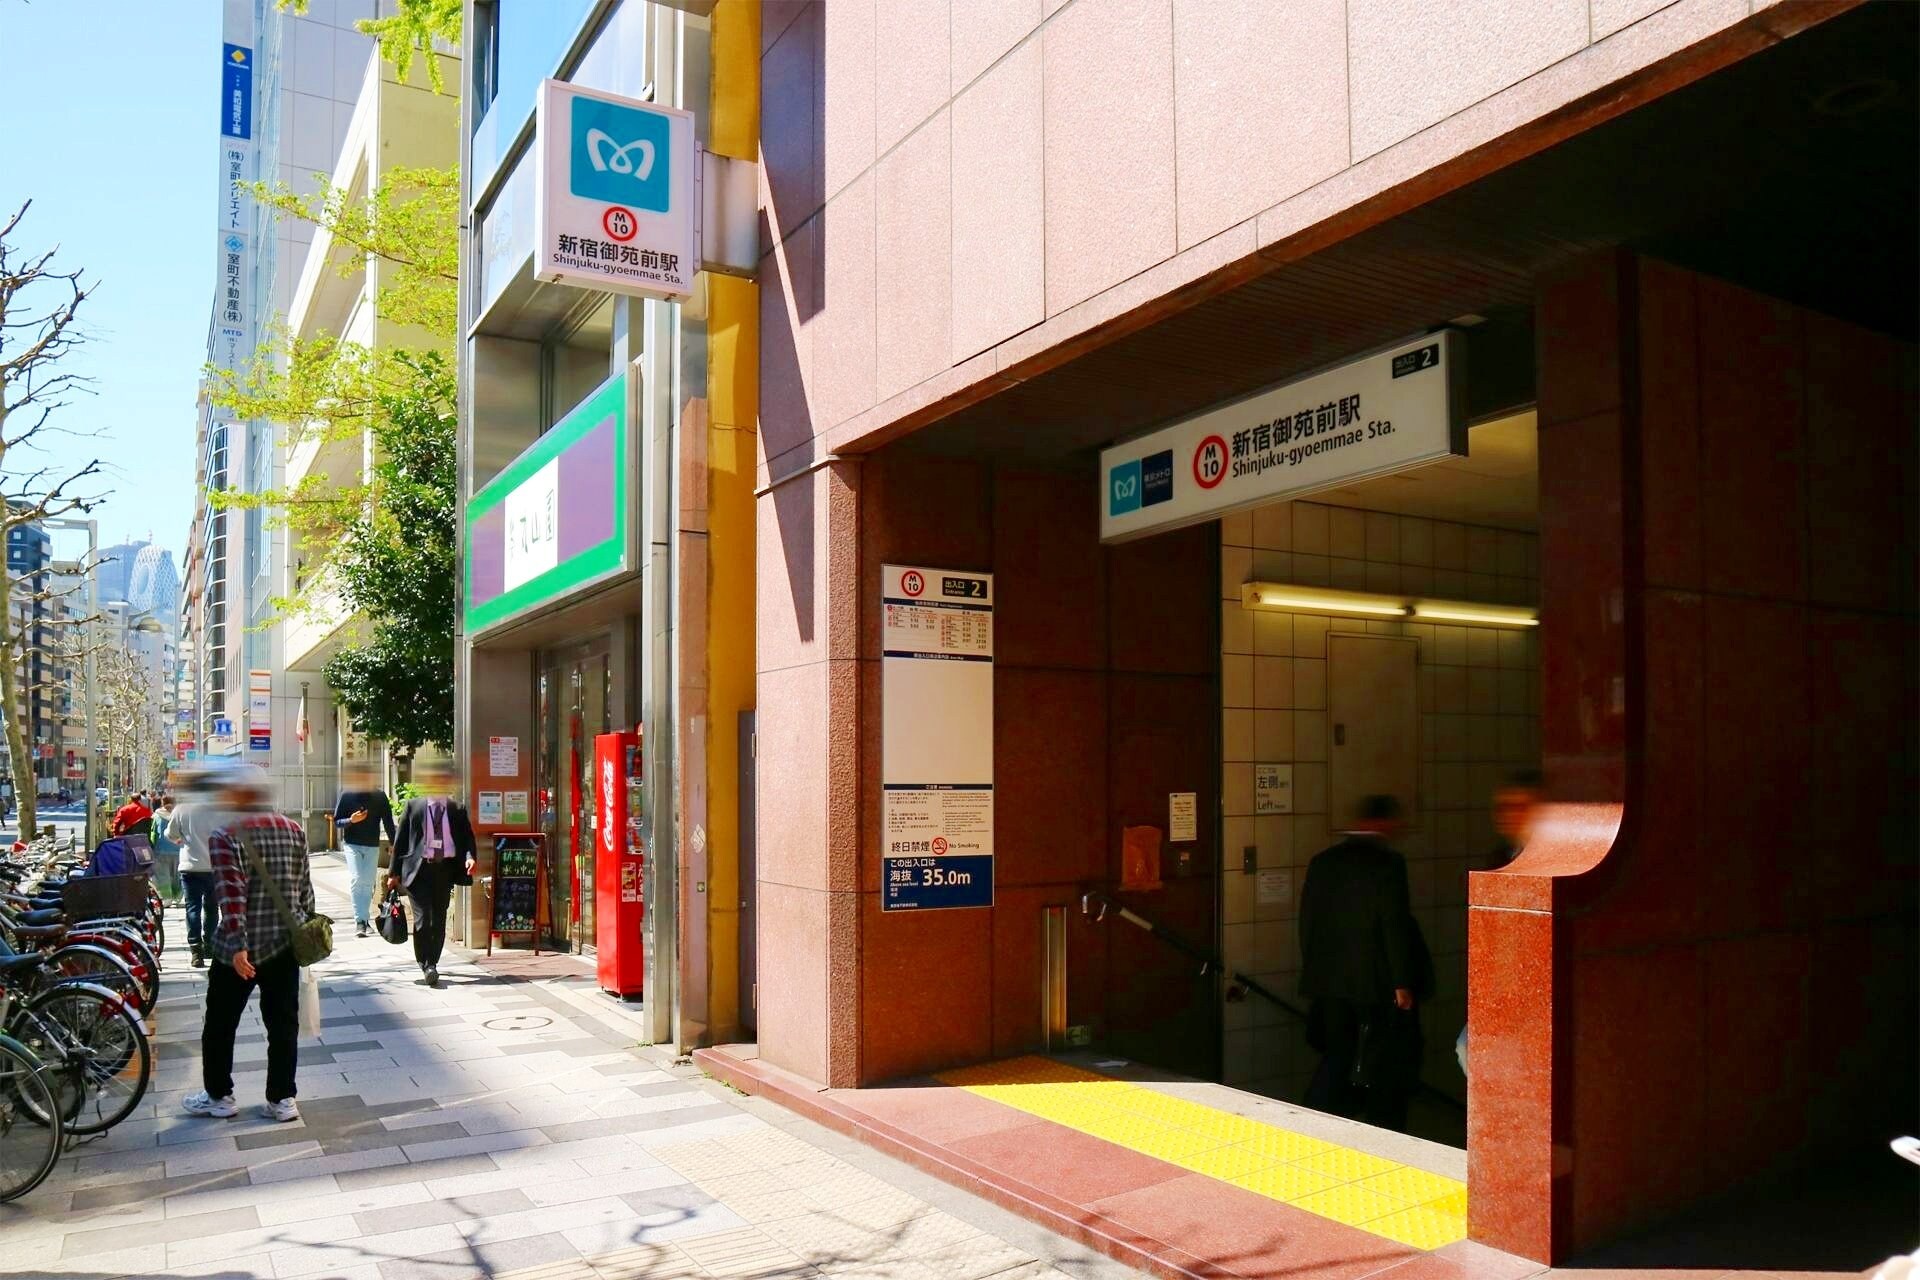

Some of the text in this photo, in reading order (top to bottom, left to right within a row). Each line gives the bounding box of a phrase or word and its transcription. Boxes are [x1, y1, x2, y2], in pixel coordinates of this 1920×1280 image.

[614, 212, 626, 223] M
[612, 223, 629, 235] 10
[558, 233, 679, 273] 新宿御苑前駅
[553, 253, 683, 285] Shinjuku-gyoemmae Sta.
[1421, 348, 1432, 367] 2
[1232, 393, 1361, 459] 新宿御苑前駅
[1205, 444, 1216, 461] M
[1232, 418, 1396, 478] Shinjuku-gyoemmae Sta.
[1203, 460, 1219, 478] 10
[908, 575, 917, 583] M
[908, 583, 919, 592] 10
[945, 580, 981, 596] 出入口 2
[891, 841, 930, 852] 終日禁煙
[890, 858, 936, 867] この出入口は
[890, 870, 912, 881] 海抜
[922, 868, 971, 886] 35.0m
